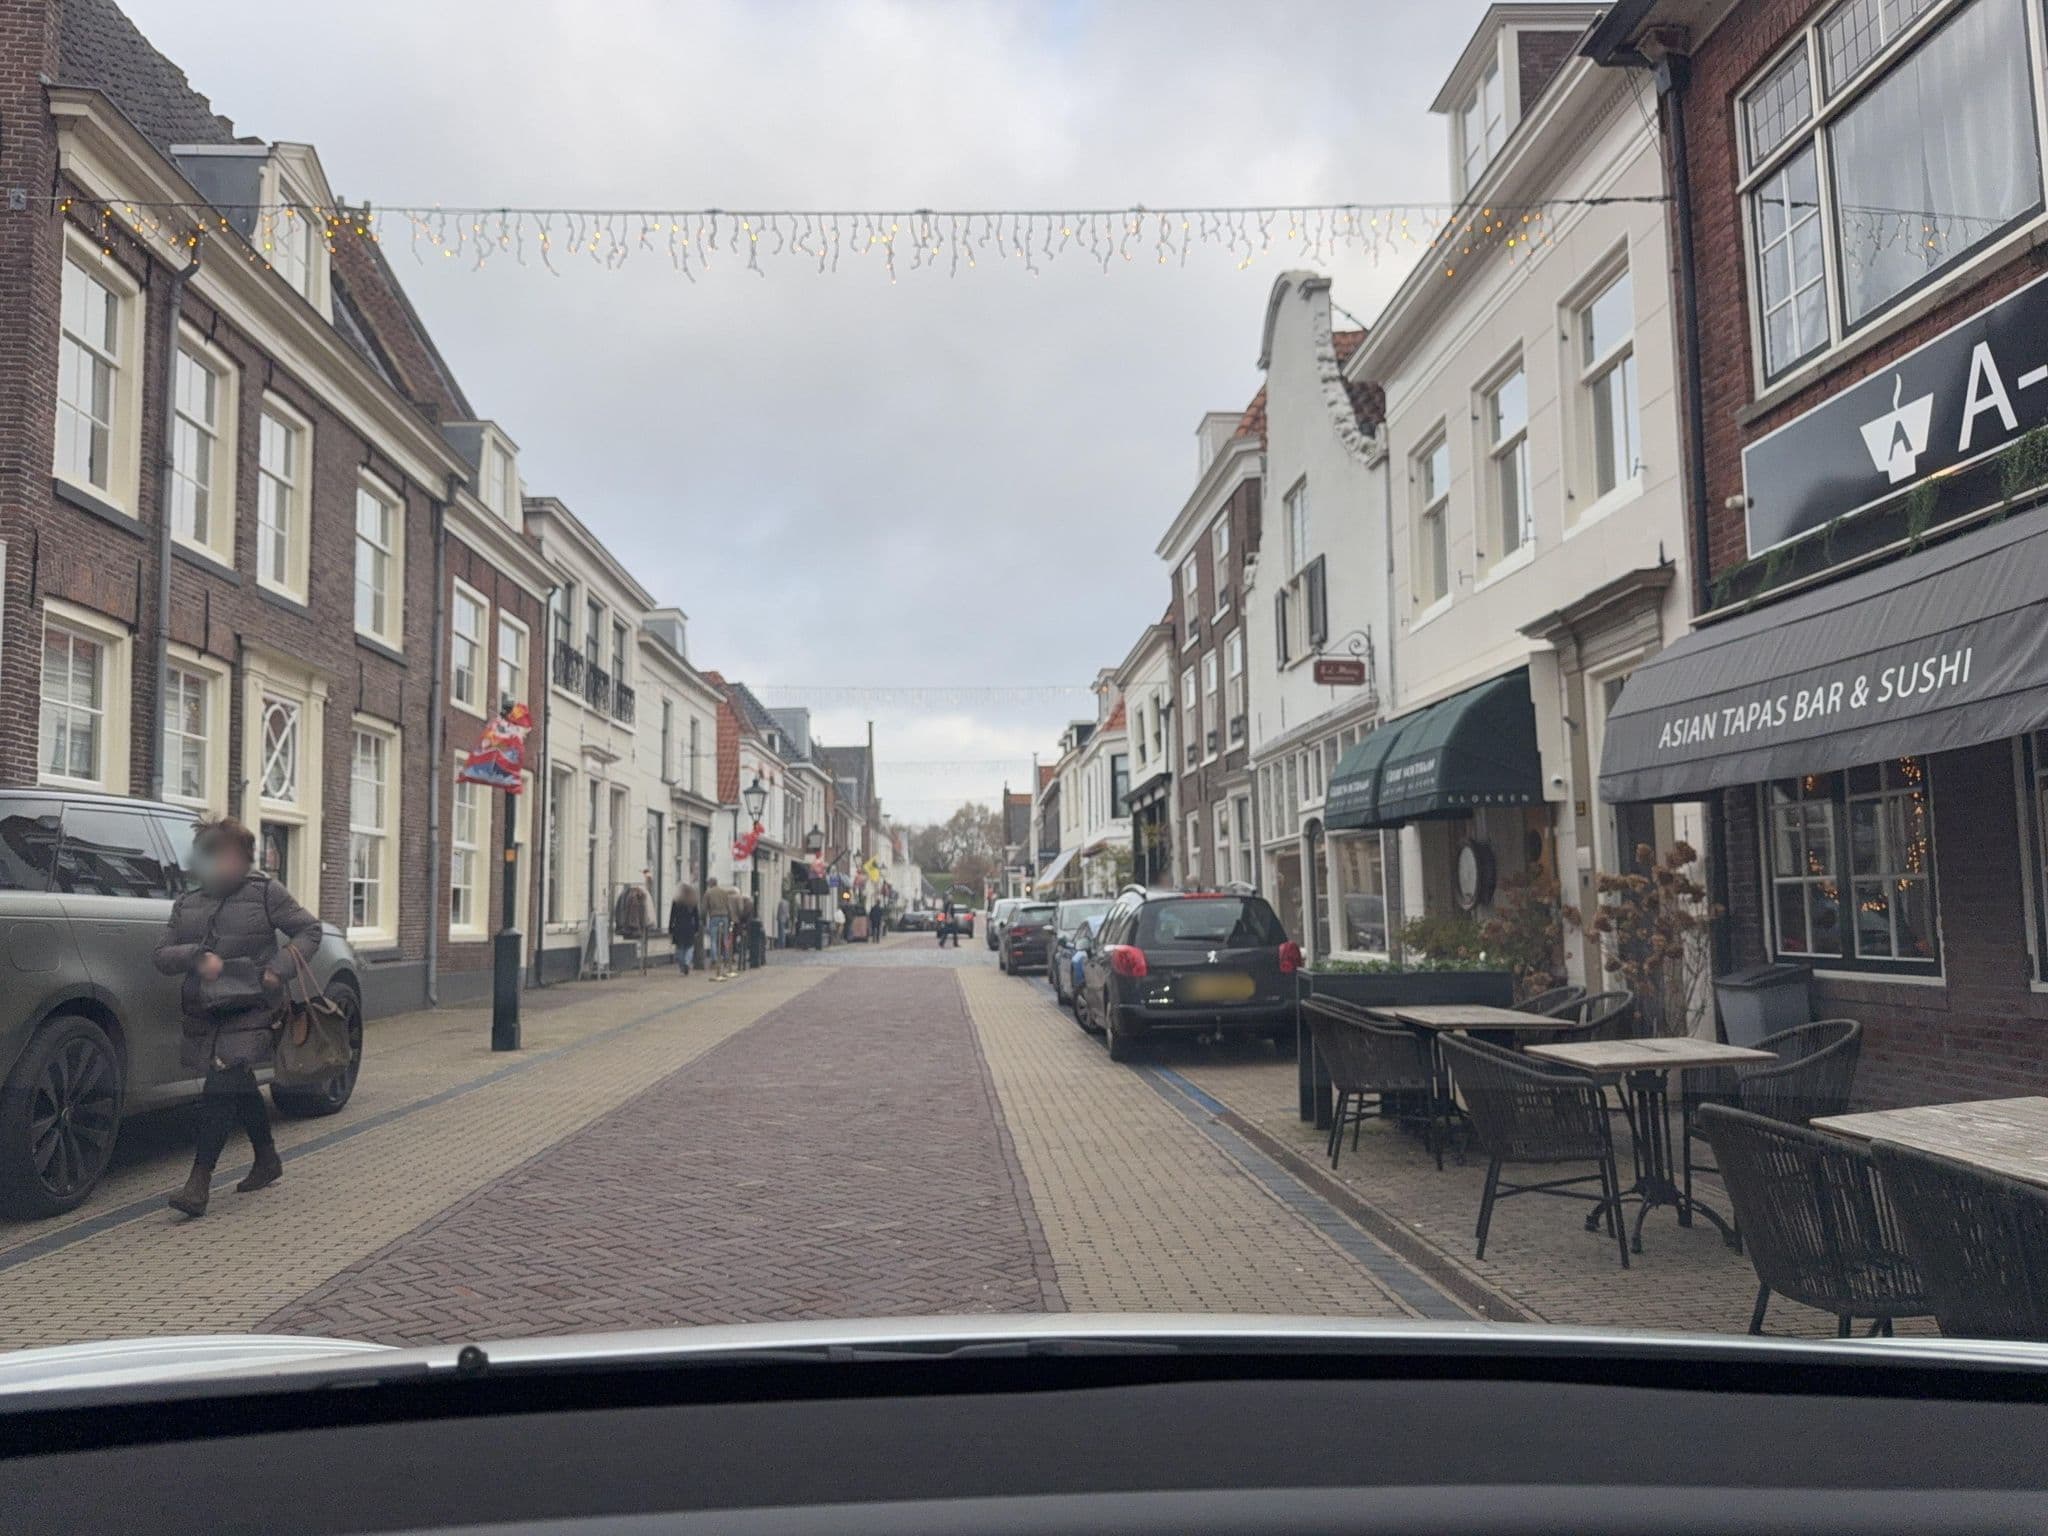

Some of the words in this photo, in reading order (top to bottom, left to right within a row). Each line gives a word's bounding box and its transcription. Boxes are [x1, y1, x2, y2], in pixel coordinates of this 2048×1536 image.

[1888, 420, 1913, 461] A
[1658, 713, 1717, 749] ASIAN
[1722, 695, 1788, 737] TAPAS
[1793, 681, 1844, 722] BAR
[1850, 675, 1869, 709] &
[1877, 648, 1972, 703] SUSHI
